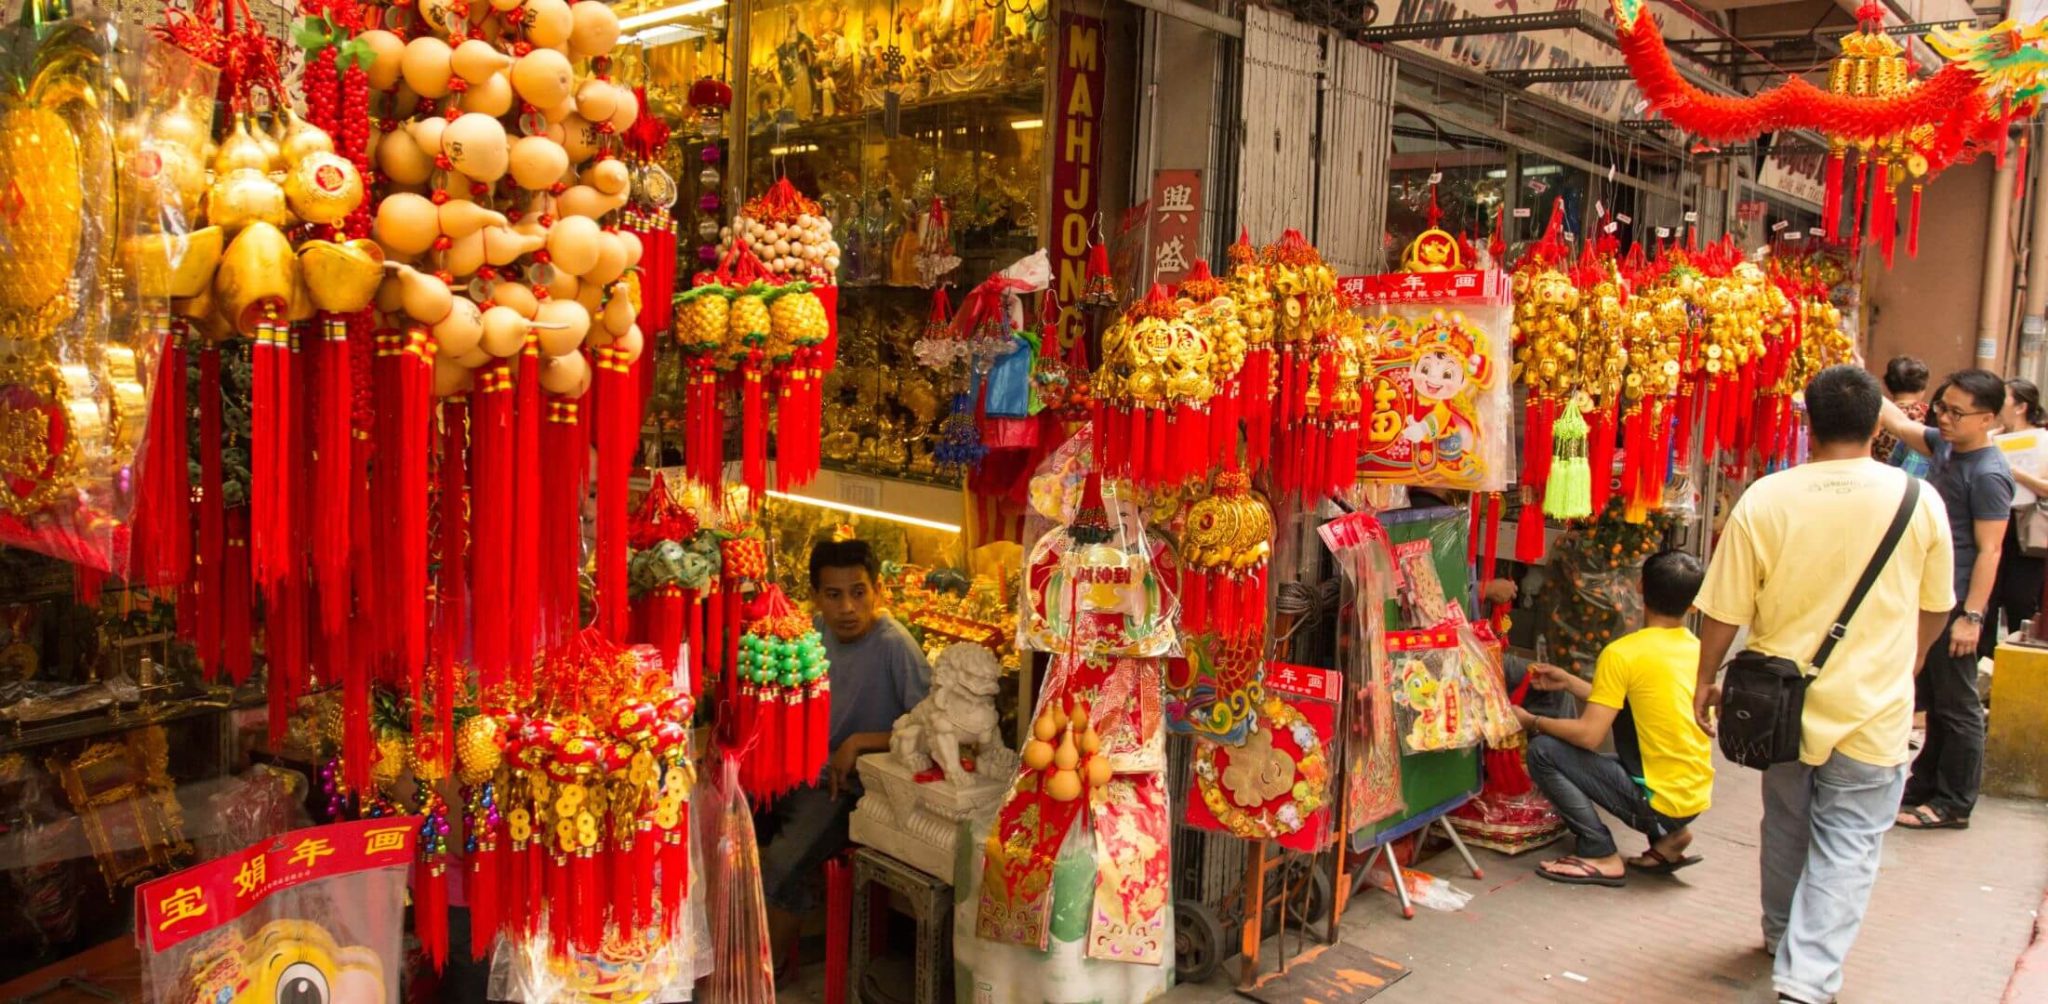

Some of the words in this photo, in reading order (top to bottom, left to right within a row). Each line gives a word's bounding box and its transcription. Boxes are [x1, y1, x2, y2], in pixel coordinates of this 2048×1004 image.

[1058, 23, 1098, 349] MAHJONG
[1155, 184, 1195, 272] 興盛
[158, 826, 412, 932] 宝娟年画
